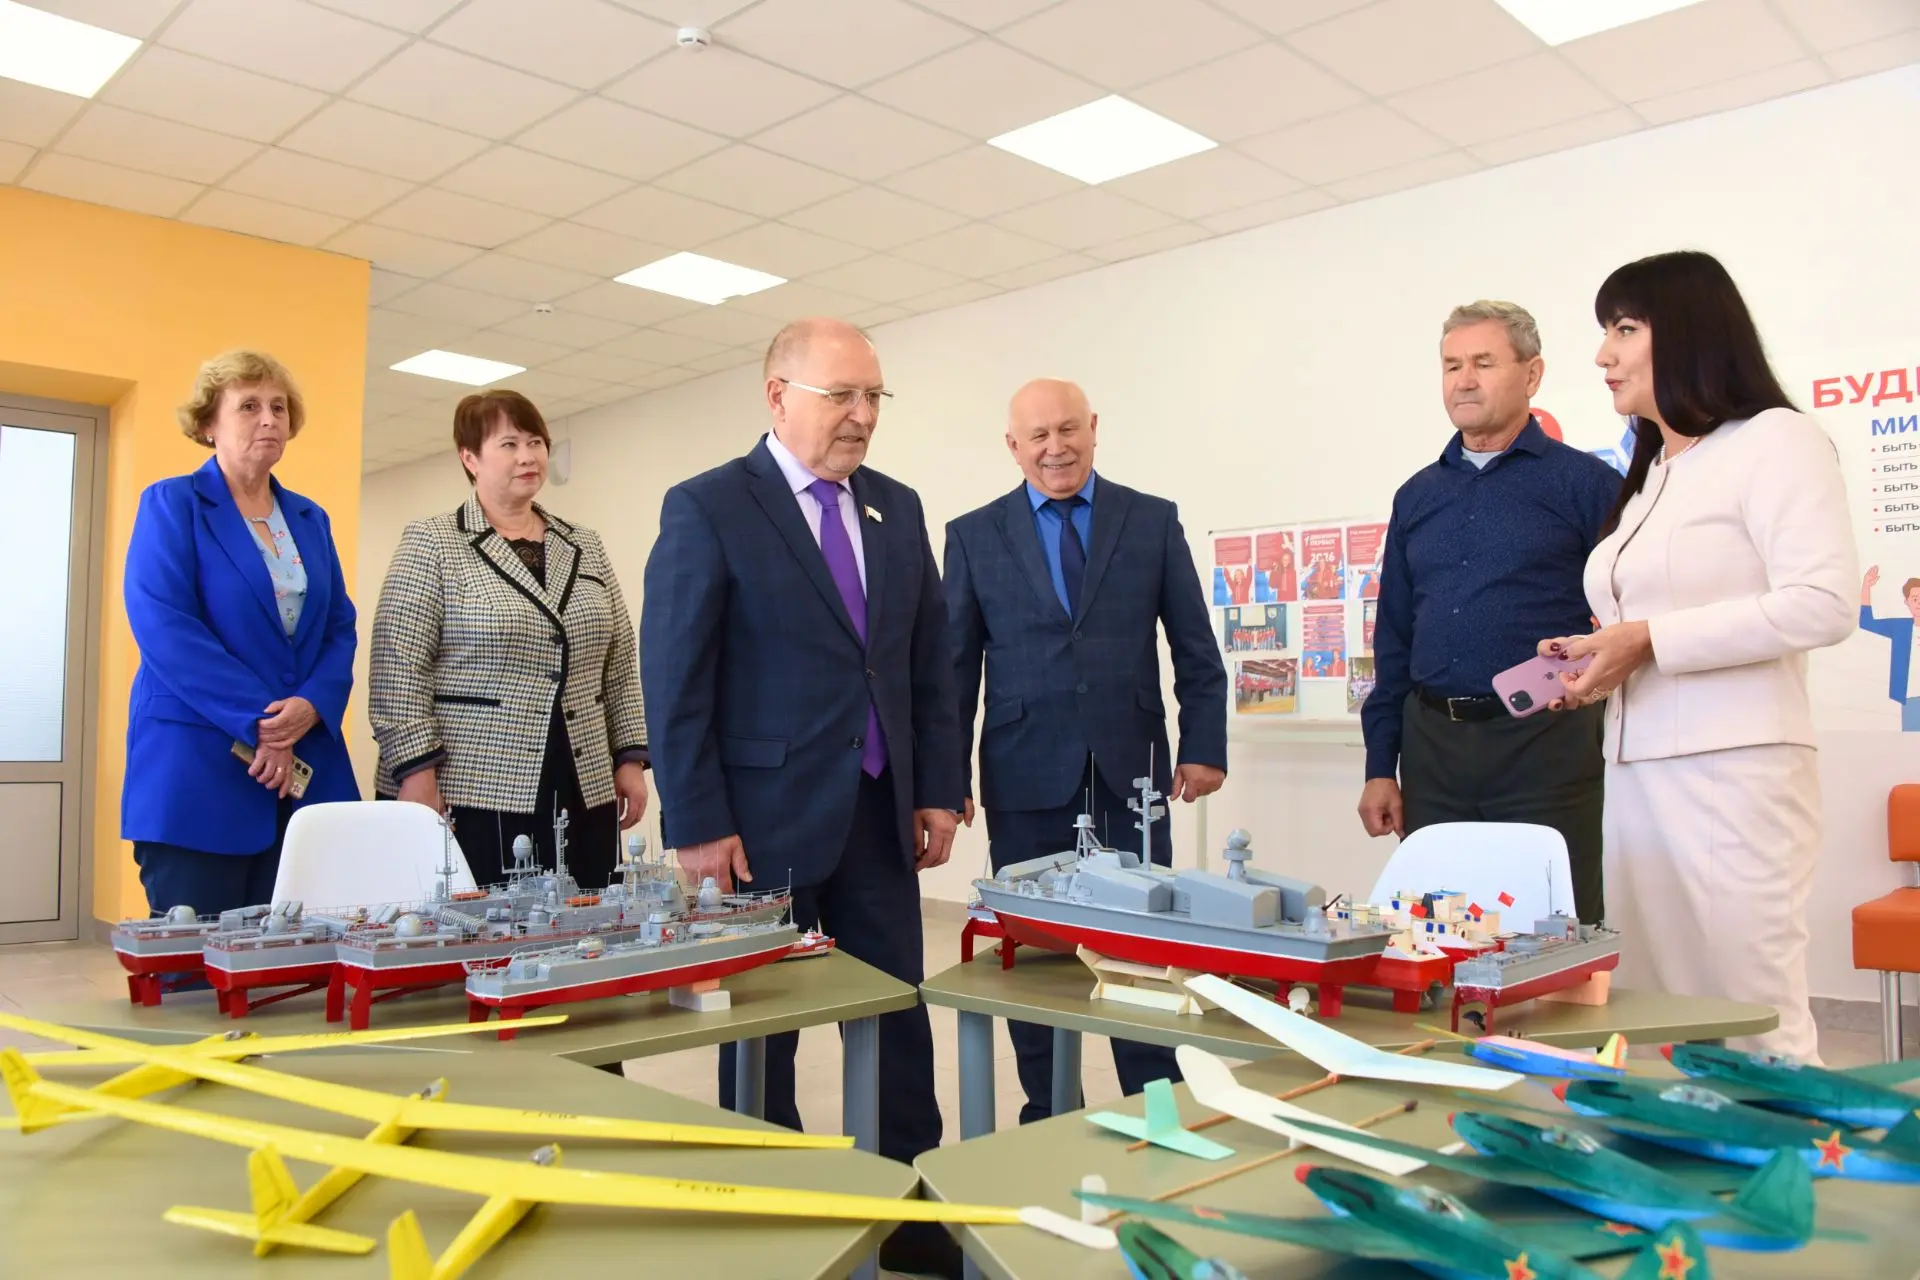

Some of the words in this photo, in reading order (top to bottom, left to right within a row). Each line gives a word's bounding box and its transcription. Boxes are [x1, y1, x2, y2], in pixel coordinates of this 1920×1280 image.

[1812, 366, 1920, 409] БУД
[1882, 442, 1917, 453] БЫТЬ
[1883, 462, 1918, 473] БЫТЬ
[1884, 483, 1918, 493] БЫТЬ
[1885, 502, 1919, 513] БЫТЬ
[1885, 523, 1920, 533] БЫТЬ
